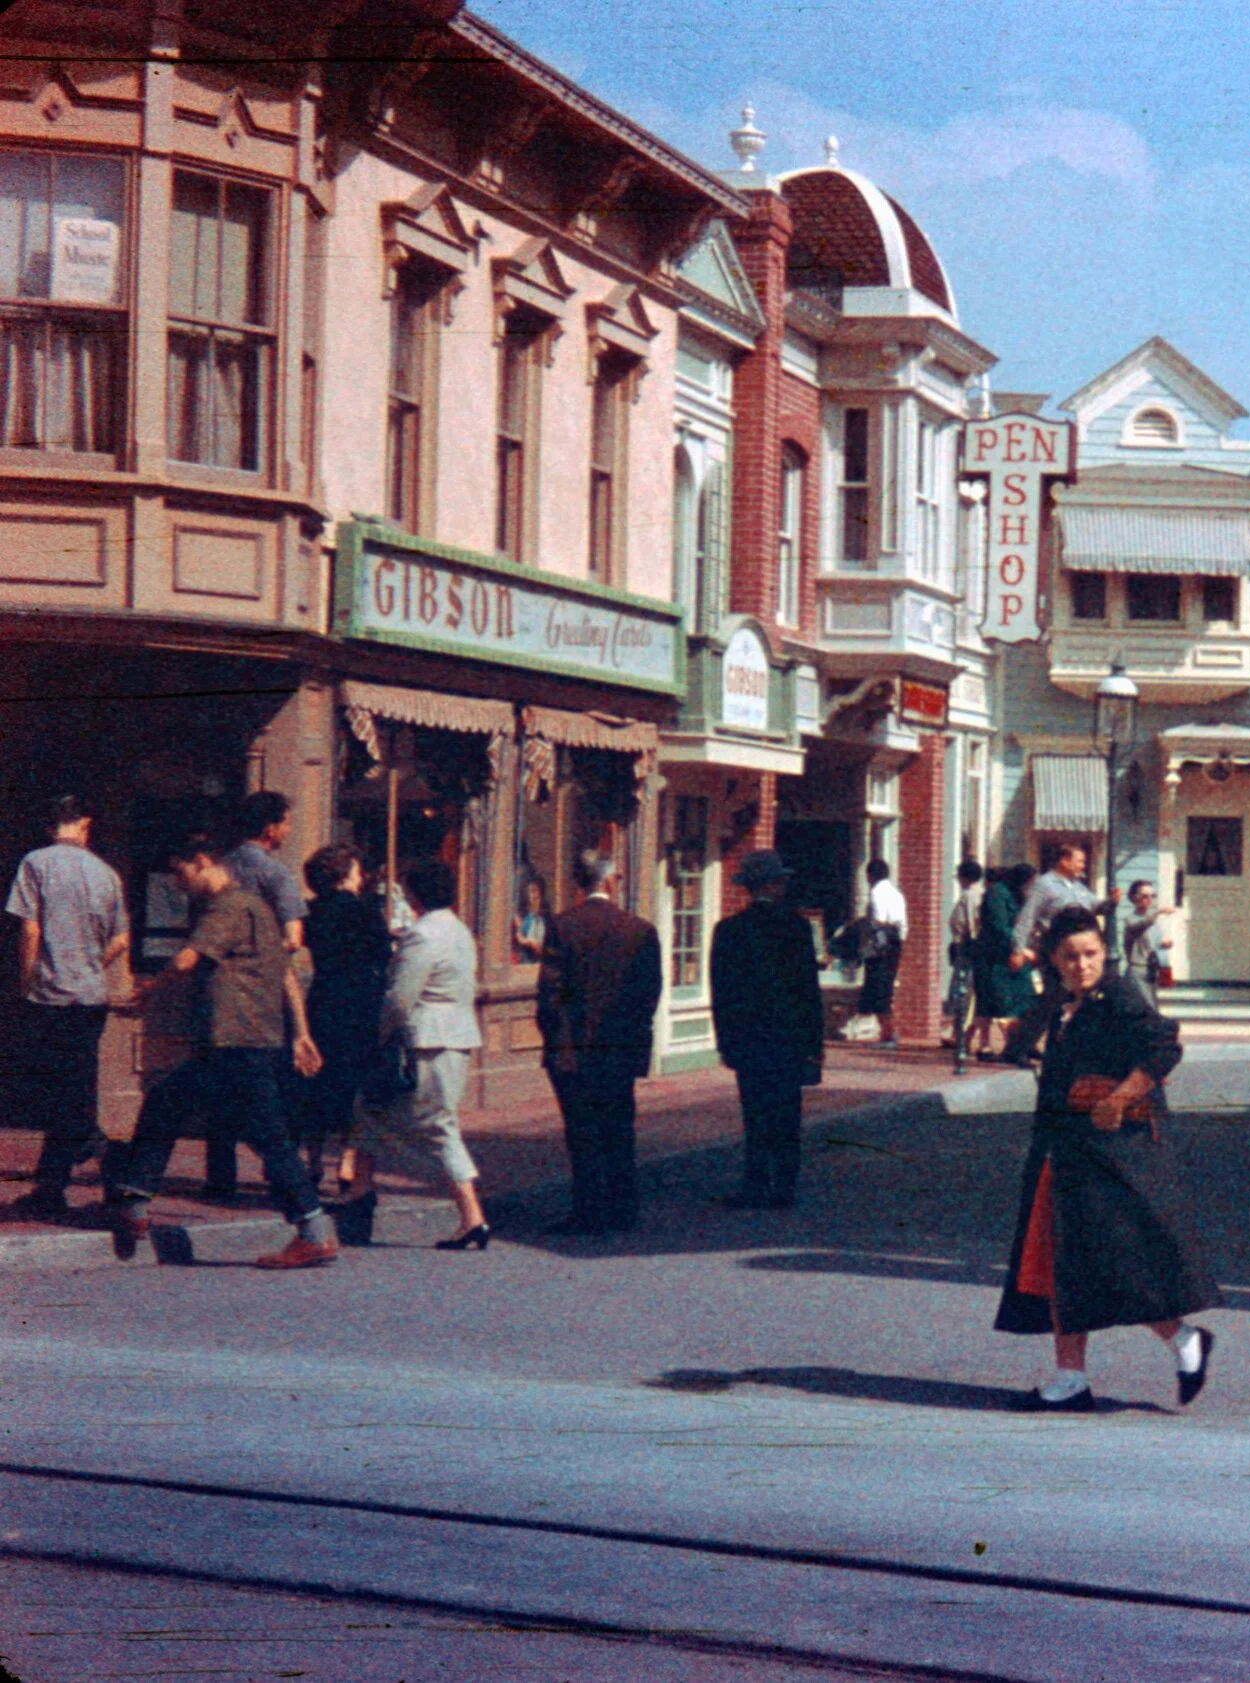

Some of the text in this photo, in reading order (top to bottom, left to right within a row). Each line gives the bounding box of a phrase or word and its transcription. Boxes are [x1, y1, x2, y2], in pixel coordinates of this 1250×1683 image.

[973, 423, 1058, 463] PEN
[998, 474, 1029, 626] SHOP
[374, 557, 516, 641] GIBSON
[545, 599, 609, 665] Greeting
